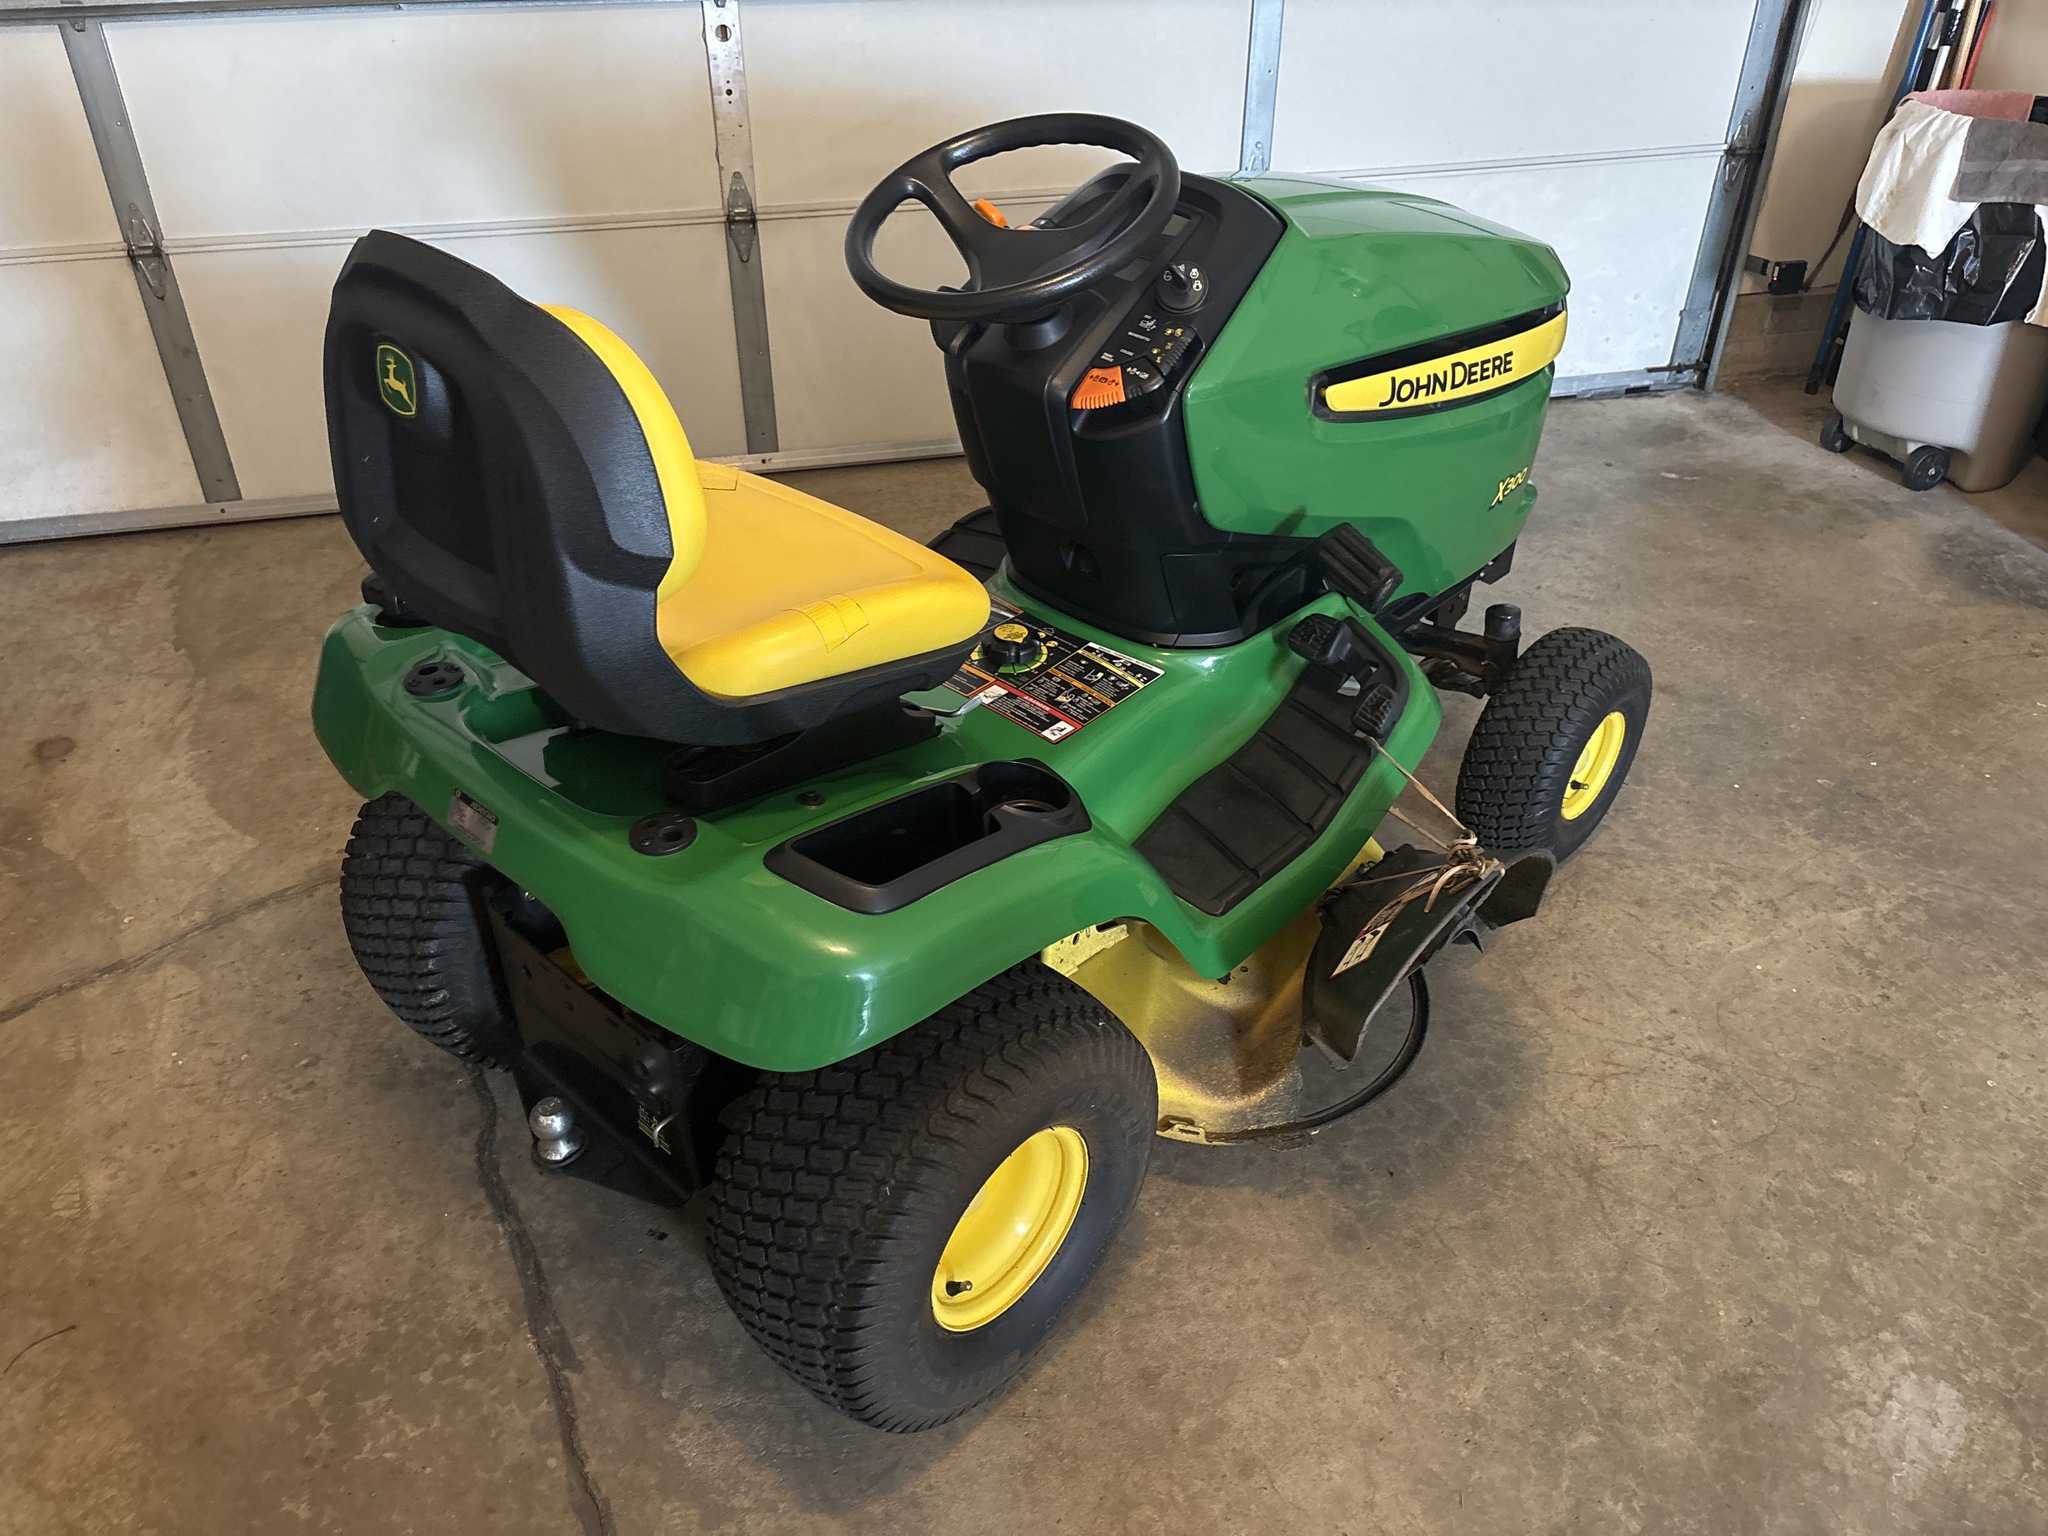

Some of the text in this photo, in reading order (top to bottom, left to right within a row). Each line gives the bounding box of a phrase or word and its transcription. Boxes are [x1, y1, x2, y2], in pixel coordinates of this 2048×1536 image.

[1378, 351, 1514, 408] JOHN DEERE
[1489, 466, 1529, 511] X300
